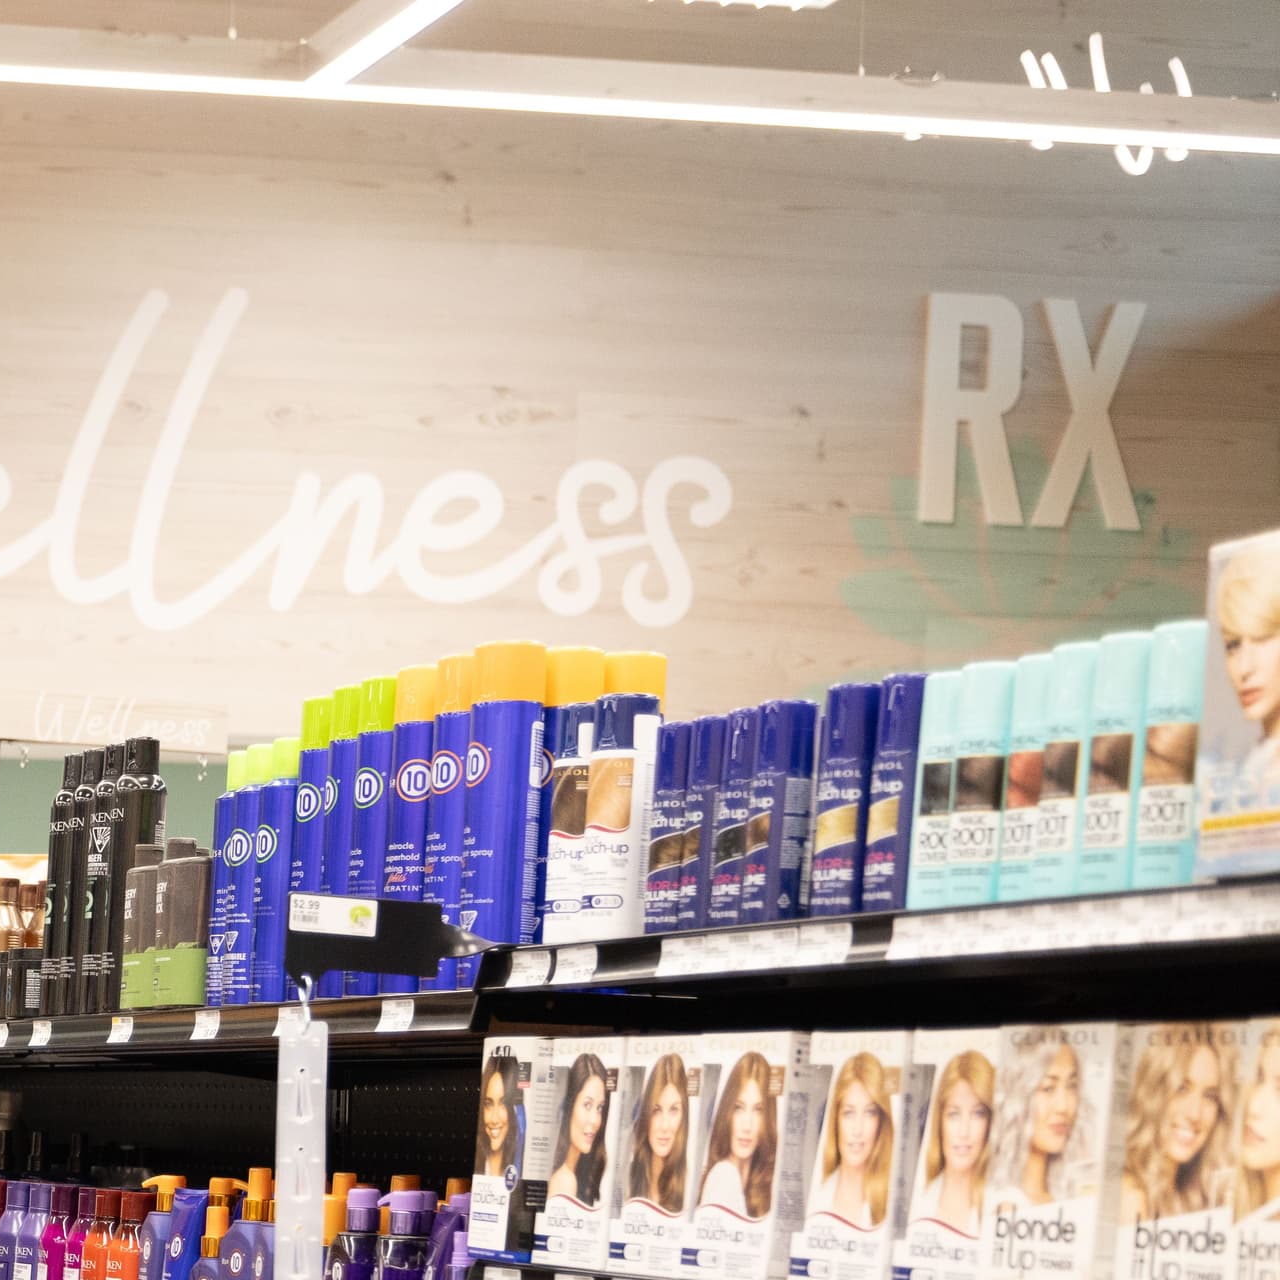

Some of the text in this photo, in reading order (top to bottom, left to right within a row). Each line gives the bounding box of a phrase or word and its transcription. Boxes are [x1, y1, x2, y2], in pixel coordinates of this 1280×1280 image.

[917, 290, 1147, 532] RX
[406, 770, 427, 792] 10
[434, 761, 451, 785] 10
[358, 777, 372, 800] 10
[293, 899, 321, 911] $2.99
[994, 1203, 1076, 1245] blonde
[1134, 1216, 1225, 1257] blonde
